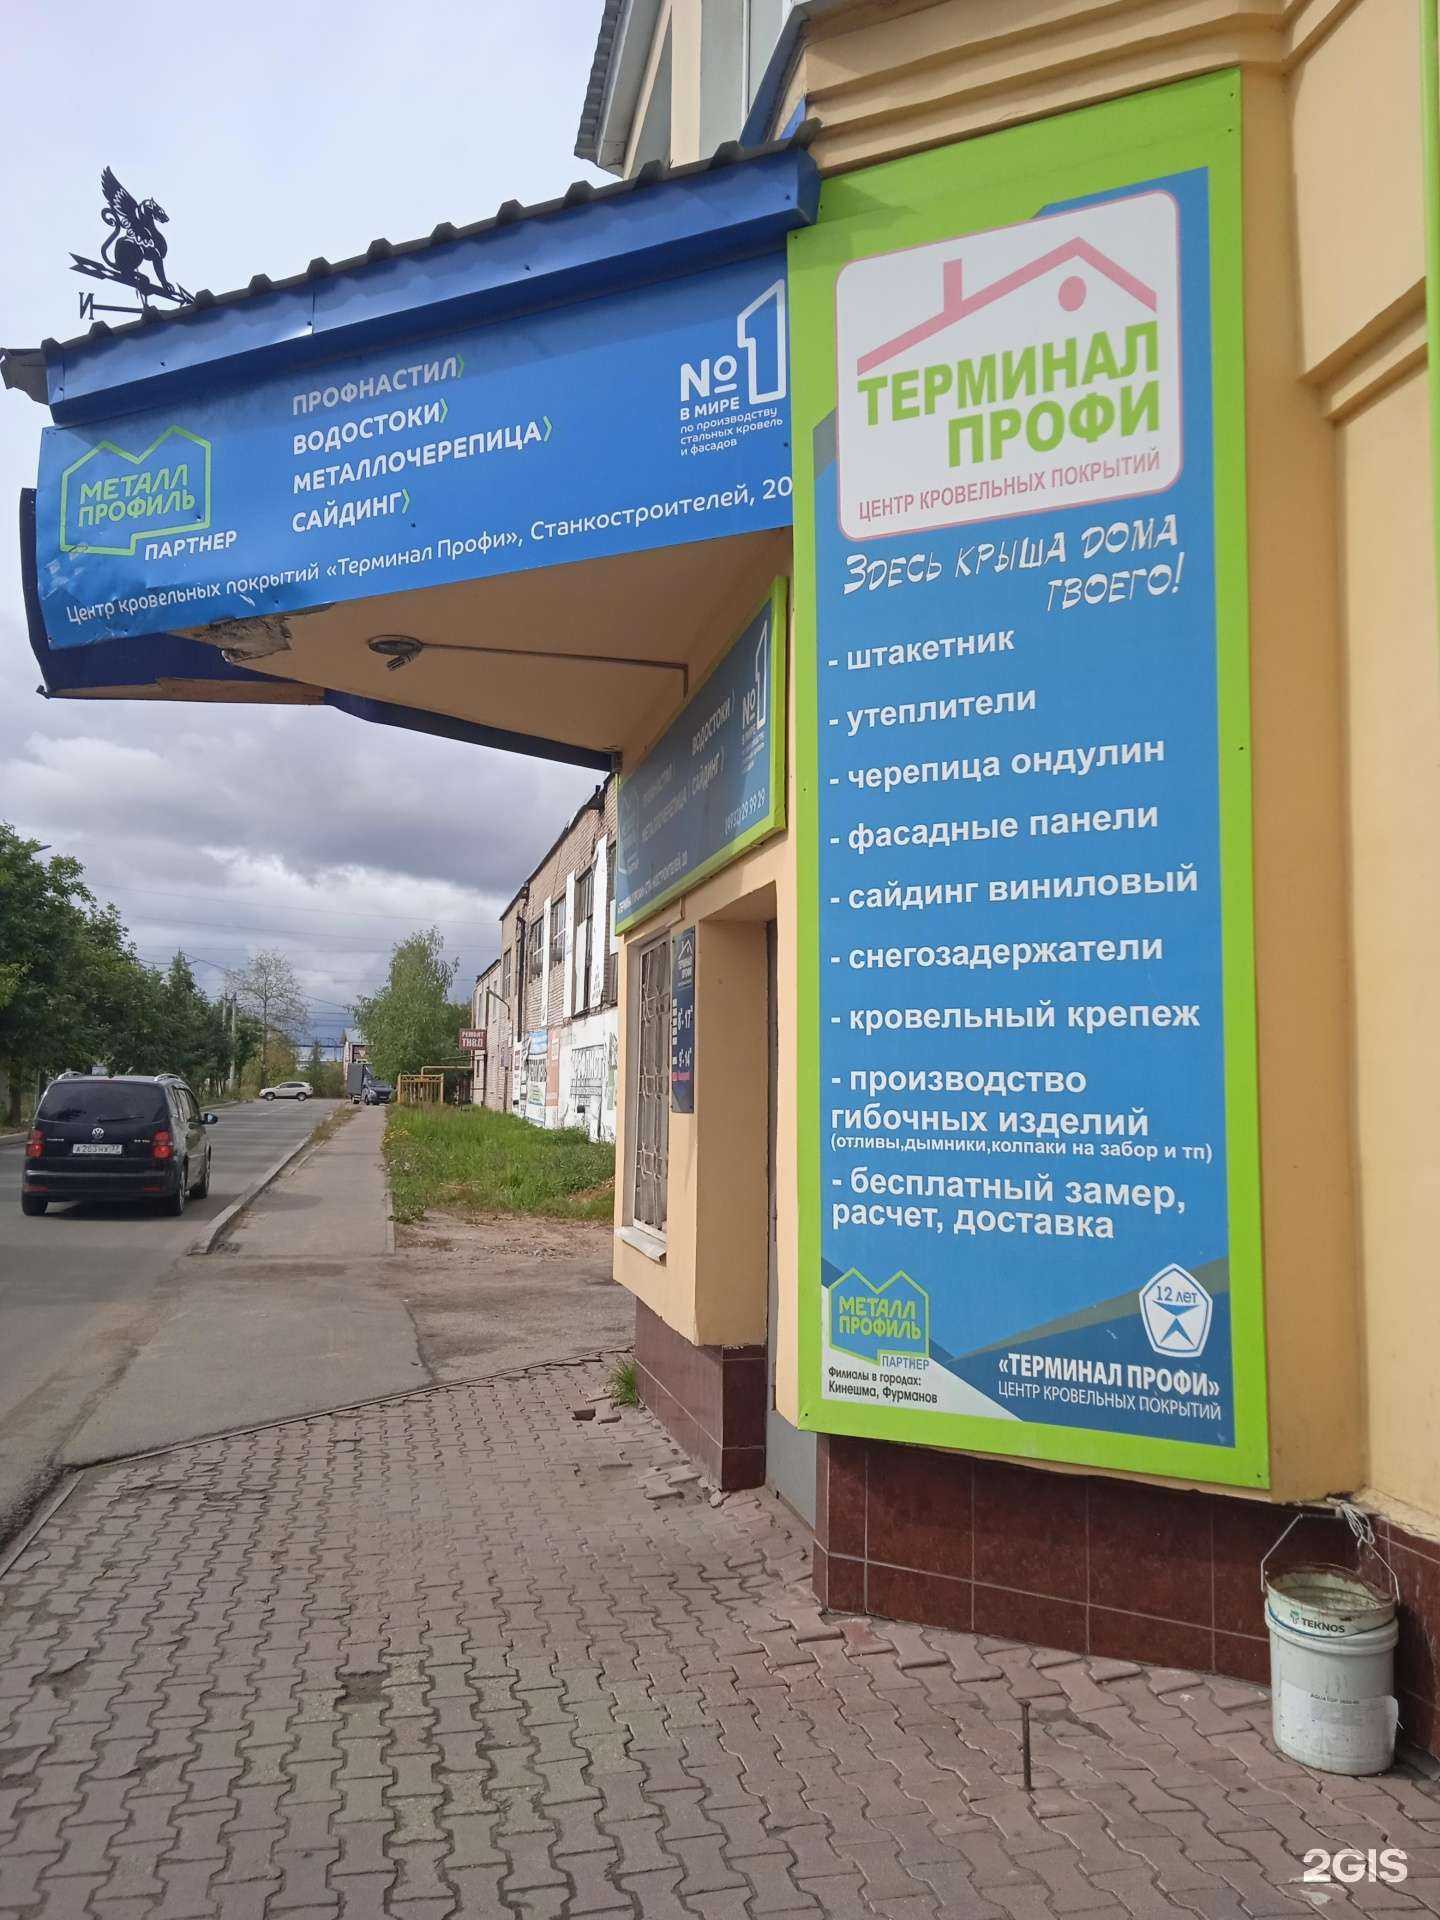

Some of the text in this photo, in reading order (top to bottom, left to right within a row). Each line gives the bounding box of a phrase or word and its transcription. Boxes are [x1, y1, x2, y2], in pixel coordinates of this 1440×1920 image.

[292, 356, 457, 415] ПРОФНАСТИЛ
[857, 320, 1159, 426] ТЕРМИНАЛ
[293, 401, 441, 455] ВОДОСТОКИ
[680, 397, 740, 421] В МИРЕ
[680, 407, 777, 434] по производству
[947, 379, 1160, 469] ПРОФИ
[680, 418, 783, 445] стальных кровель
[680, 438, 737, 456] и фасадов
[293, 421, 542, 493] МЕТАЛЛОЧЕРЕПИЦА
[80, 464, 188, 504] МЕТАЛЛ
[858, 446, 1160, 522] ЦЕНТР КРОВЕЛЬНЫХ ПОКРЫТИЙ
[78, 489, 196, 528] ПРОФИЛЬ
[292, 491, 402, 532] САЙДИНГ
[66, 476, 793, 625] Центр кровельных покрытий «Терминал Профи», Станкостроителей, 20
[145, 531, 237, 560] ПАРТНЕР
[955, 531, 1067, 578] КРЫША
[1080, 513, 1178, 560] ДОМА
[846, 629, 1016, 671] штакетник
[846, 689, 1037, 737] утеплители
[847, 754, 1001, 793] черепица
[1010, 739, 1166, 775] ондулин
[847, 815, 1019, 855] фасадные
[1029, 805, 1159, 836] панели
[847, 880, 980, 911] сайдинг
[988, 862, 1199, 903] виниловый
[848, 937, 1163, 971] снегозадержатели
[848, 999, 1056, 1036] кровельный
[1066, 1003, 1201, 1034] крепеж
[849, 1067, 1088, 1097] производство
[830, 1102, 1149, 1139] гибочных изделий
[1072, 1142, 1094, 1157] на
[1099, 1141, 1158, 1162] забор
[1164, 1146, 1177, 1160] и
[1181, 1143, 1214, 1164] тп)
[850, 1166, 1054, 1203] бесплатный
[1064, 1180, 1186, 1215] замер,
[831, 1201, 1115, 1240] расчет, доставка
[839, 1296, 916, 1319] МЕТАЛЛ
[1156, 1285, 1198, 1303] 12 лет
[840, 1315, 921, 1340] ПРОФИЛЬ
[828, 1366, 922, 1386] Филиалы в городах:
[882, 1356, 930, 1370] ПАРТНЕР
[998, 1353, 1221, 1397] «ТЕРМИНАЛ ПРОФИ»
[828, 1380, 938, 1404] Кинешма, Фурманов
[998, 1380, 1222, 1421] ЦЕНТР КРОВЕЛЬНЫХ ПОКРЫТИЙ
[1302, 1617, 1345, 1633] TEKNOS
